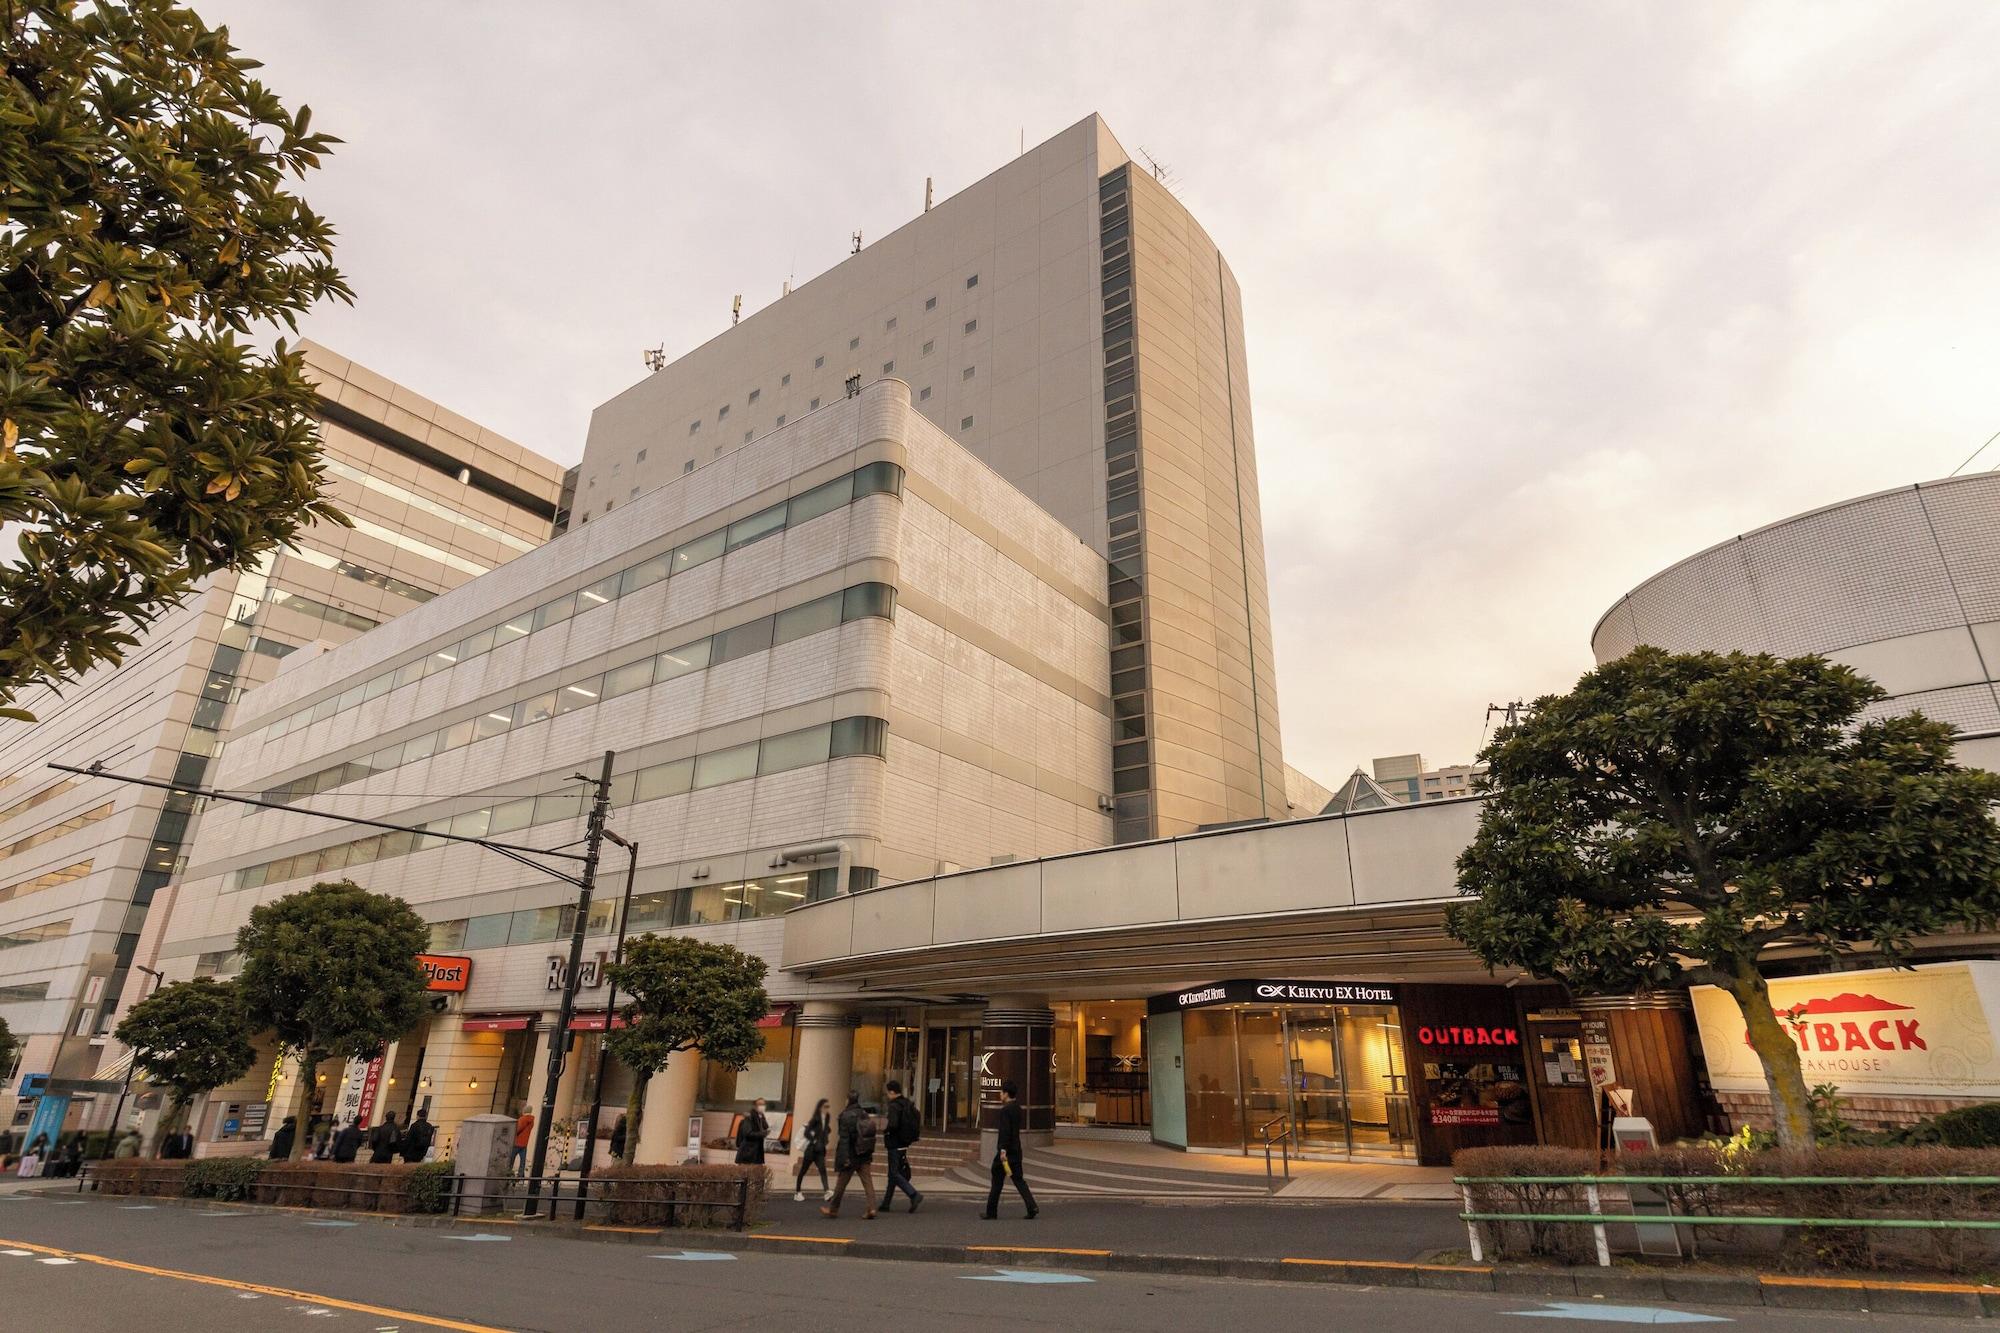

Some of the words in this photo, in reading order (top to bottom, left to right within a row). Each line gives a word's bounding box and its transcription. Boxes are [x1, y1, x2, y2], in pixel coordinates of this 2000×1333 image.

[424, 962, 463, 982] Host
[1288, 985, 1333, 999] KEIKYU
[1335, 986, 1354, 999] EX
[1355, 987, 1393, 1000] HOTEL
[1419, 1026, 1519, 1045] OUTBACK
[1744, 1019, 1928, 1051] TBACK
[1799, 1058, 1882, 1071] EAKHOUSE
